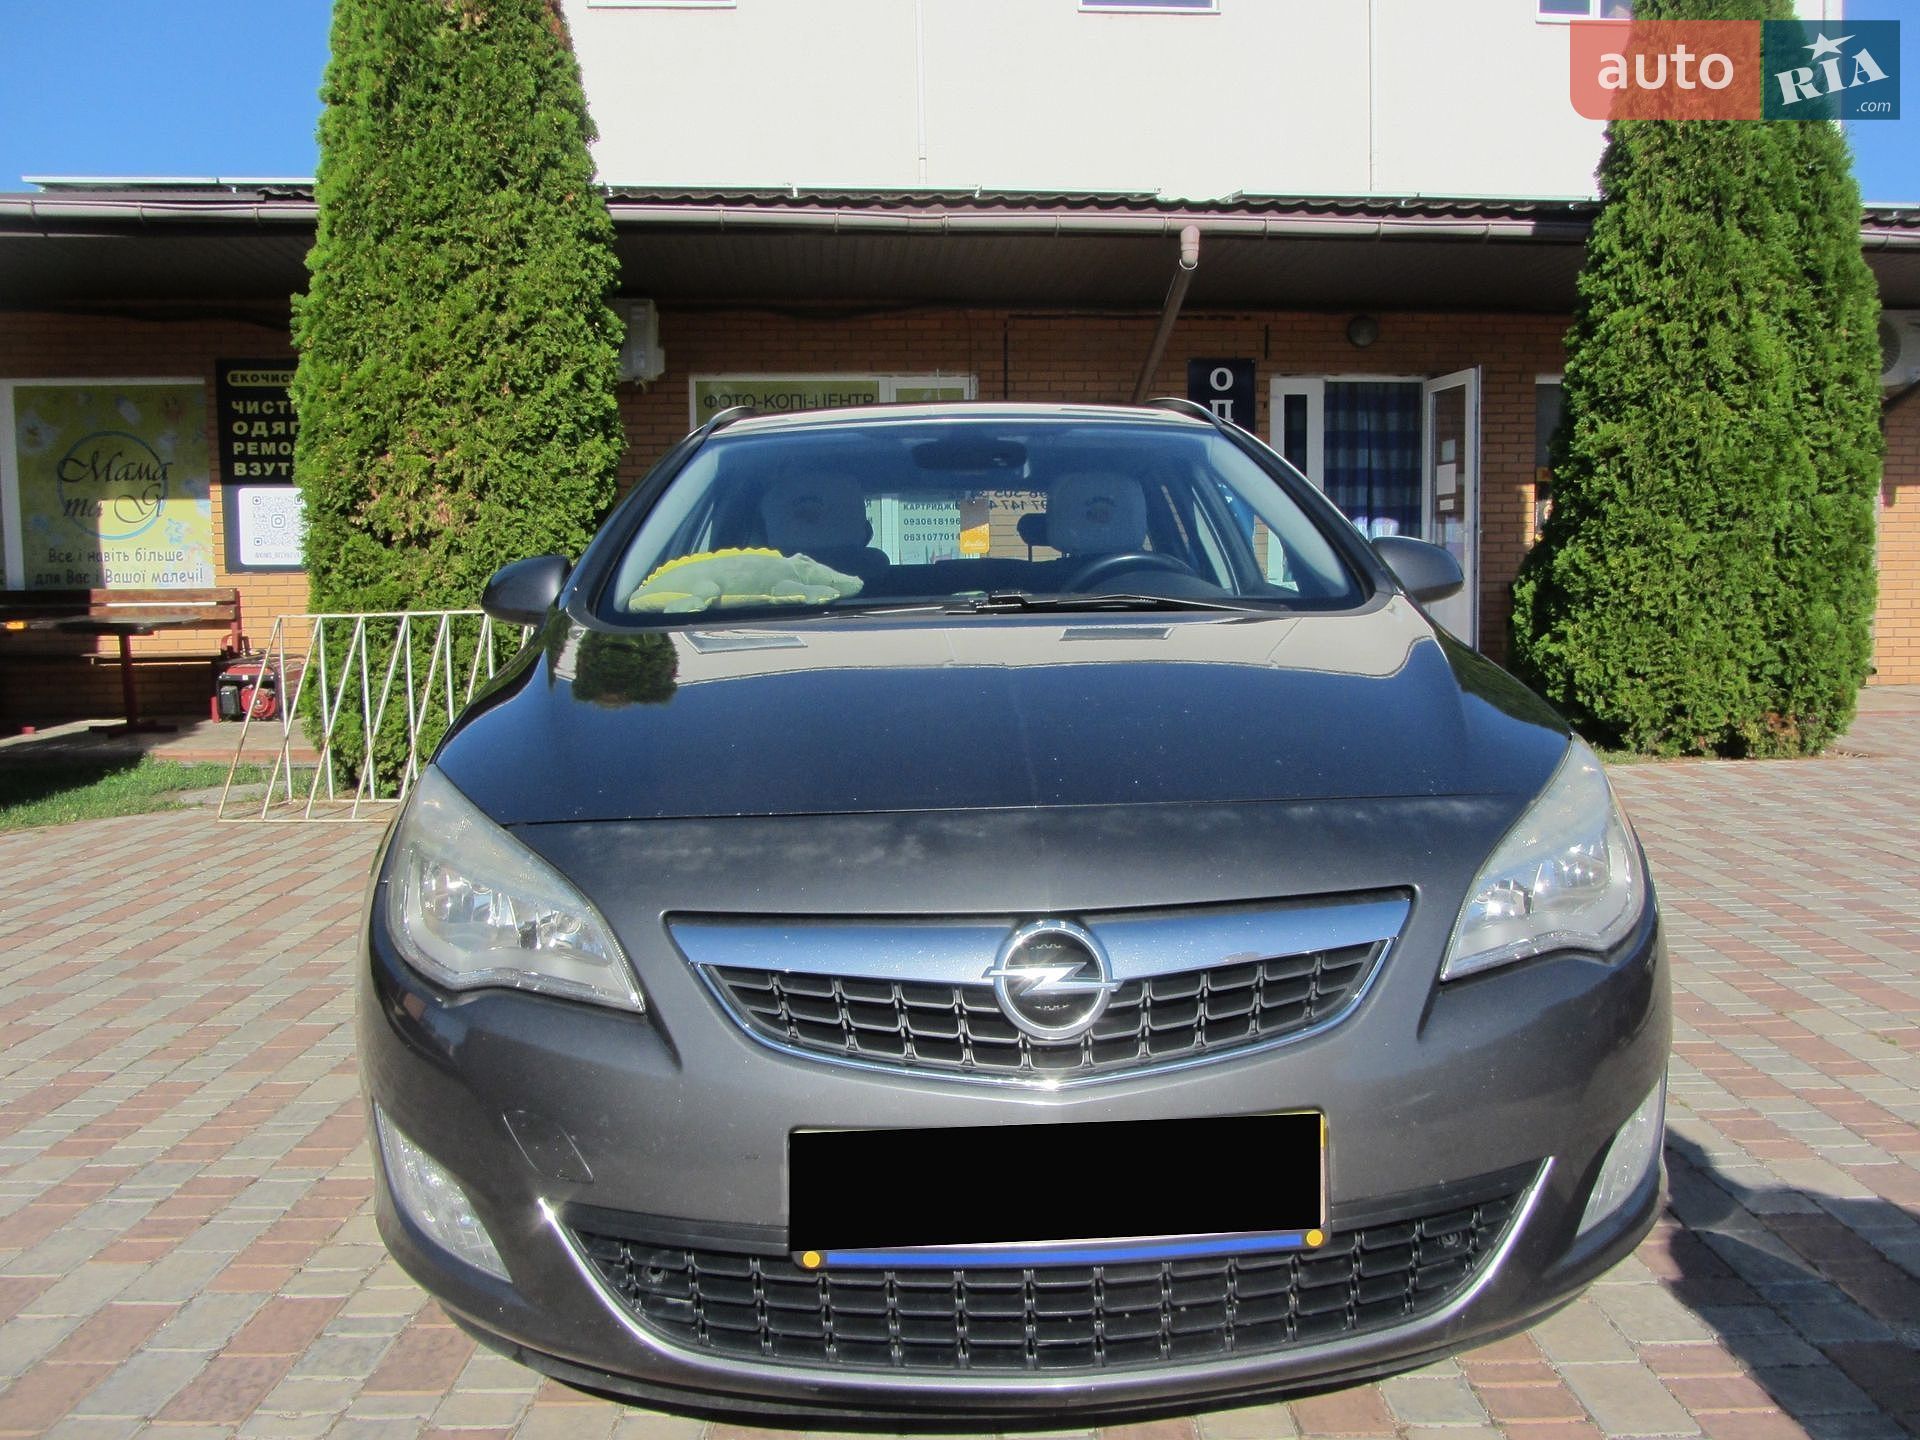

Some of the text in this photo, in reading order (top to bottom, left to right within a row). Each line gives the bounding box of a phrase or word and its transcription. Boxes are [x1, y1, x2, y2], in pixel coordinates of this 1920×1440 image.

[230, 374, 294, 383] ЕКОЧИС
[232, 421, 300, 437] ОДЯГ
[233, 442, 294, 455] РЕМО
[233, 462, 292, 476] ВЗУТ
[88, 549, 130, 562] навіть
[135, 548, 184, 562] більше
[105, 568, 146, 584] Вашої
